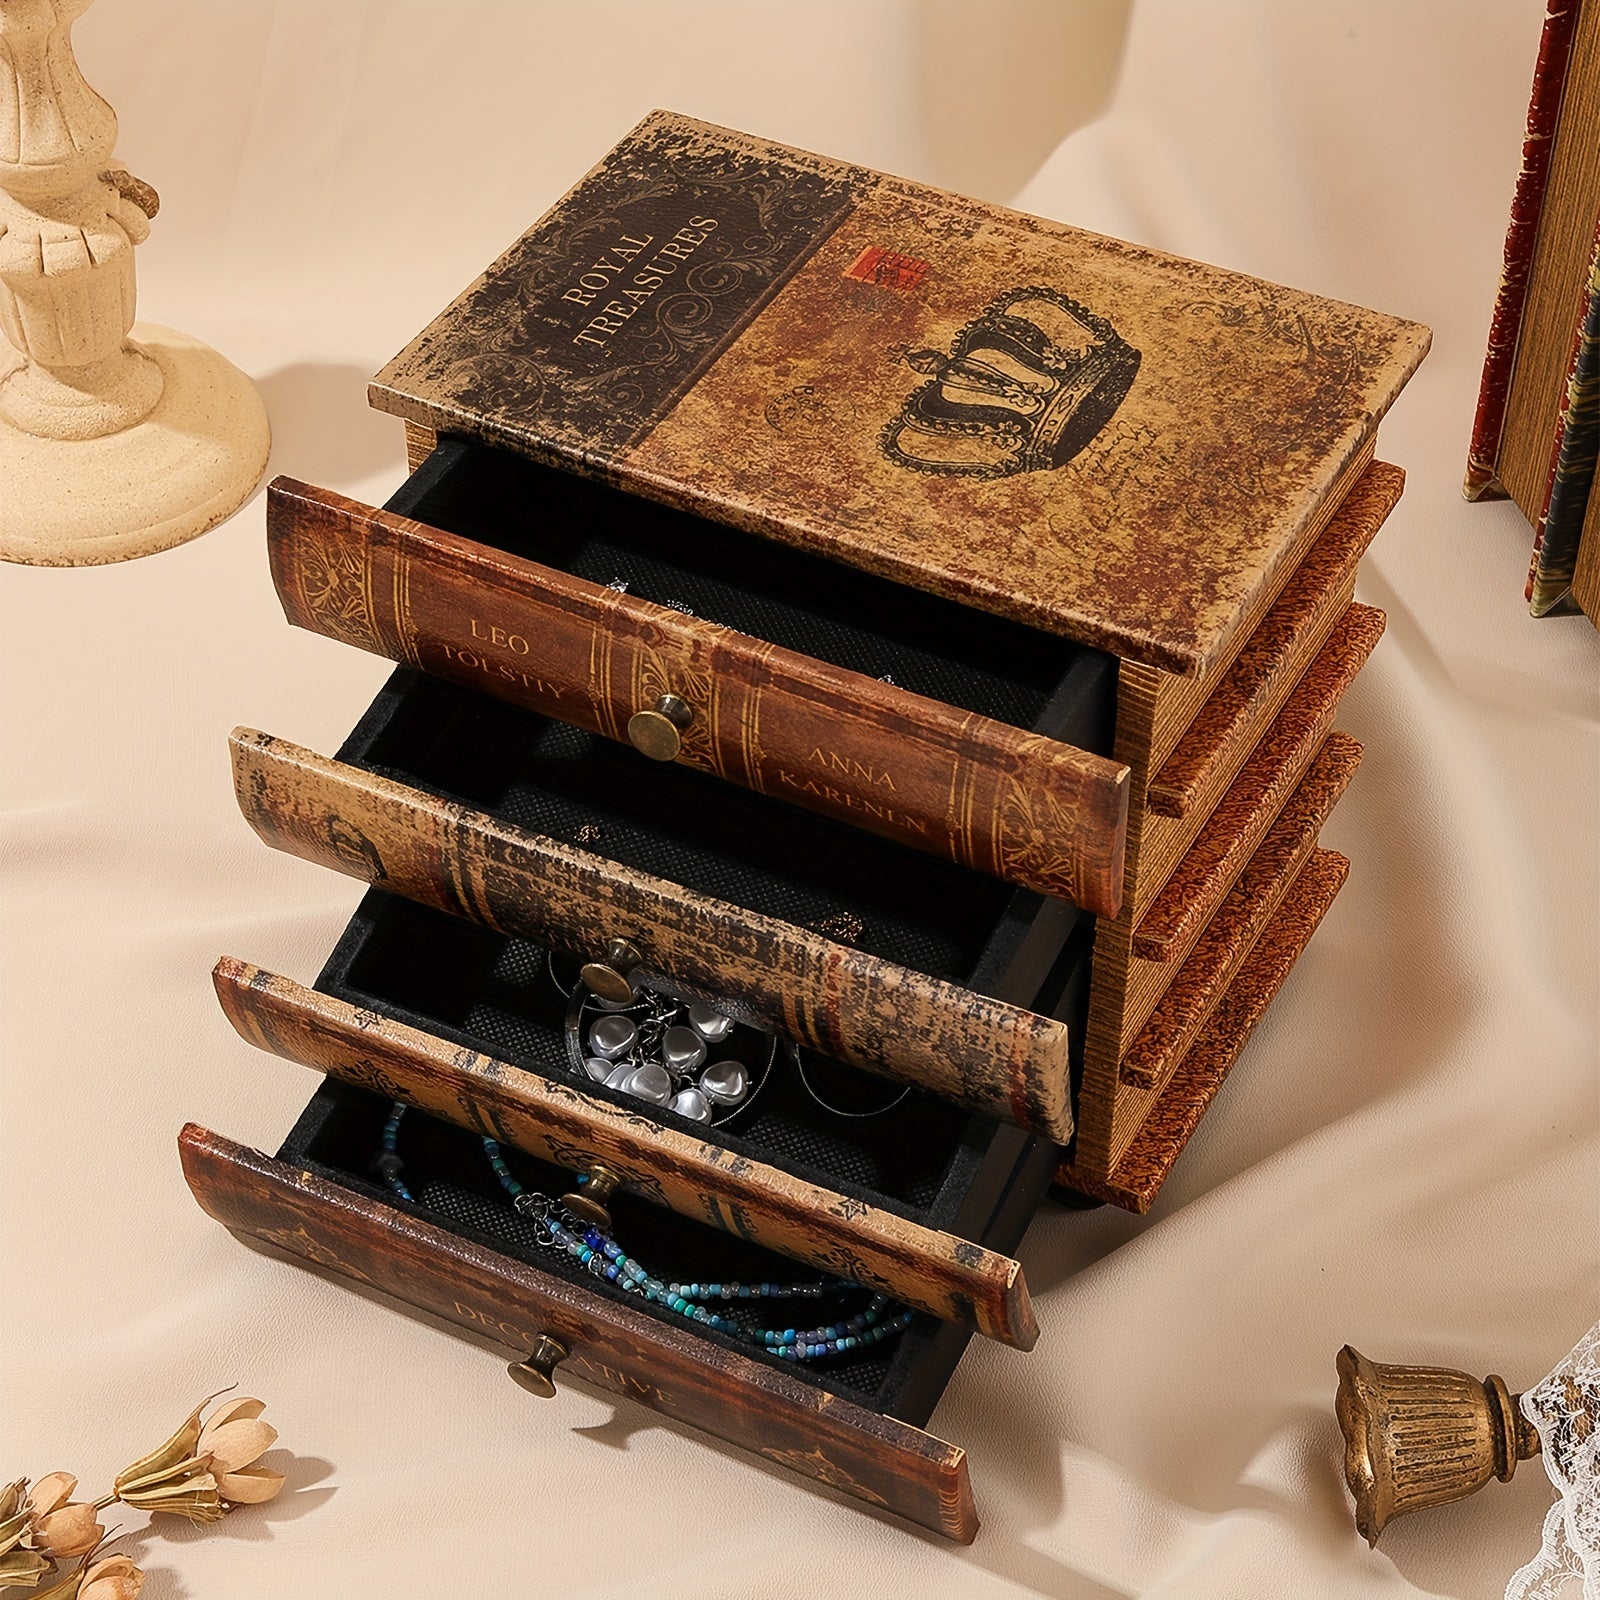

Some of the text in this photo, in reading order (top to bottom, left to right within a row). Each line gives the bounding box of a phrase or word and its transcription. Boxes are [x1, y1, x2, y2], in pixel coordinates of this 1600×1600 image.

[561, 234, 654, 307] ROYAL
[573, 215, 719, 348] TREASURES
[470, 619, 530, 655] LEO
[808, 747, 896, 791] ANNA
